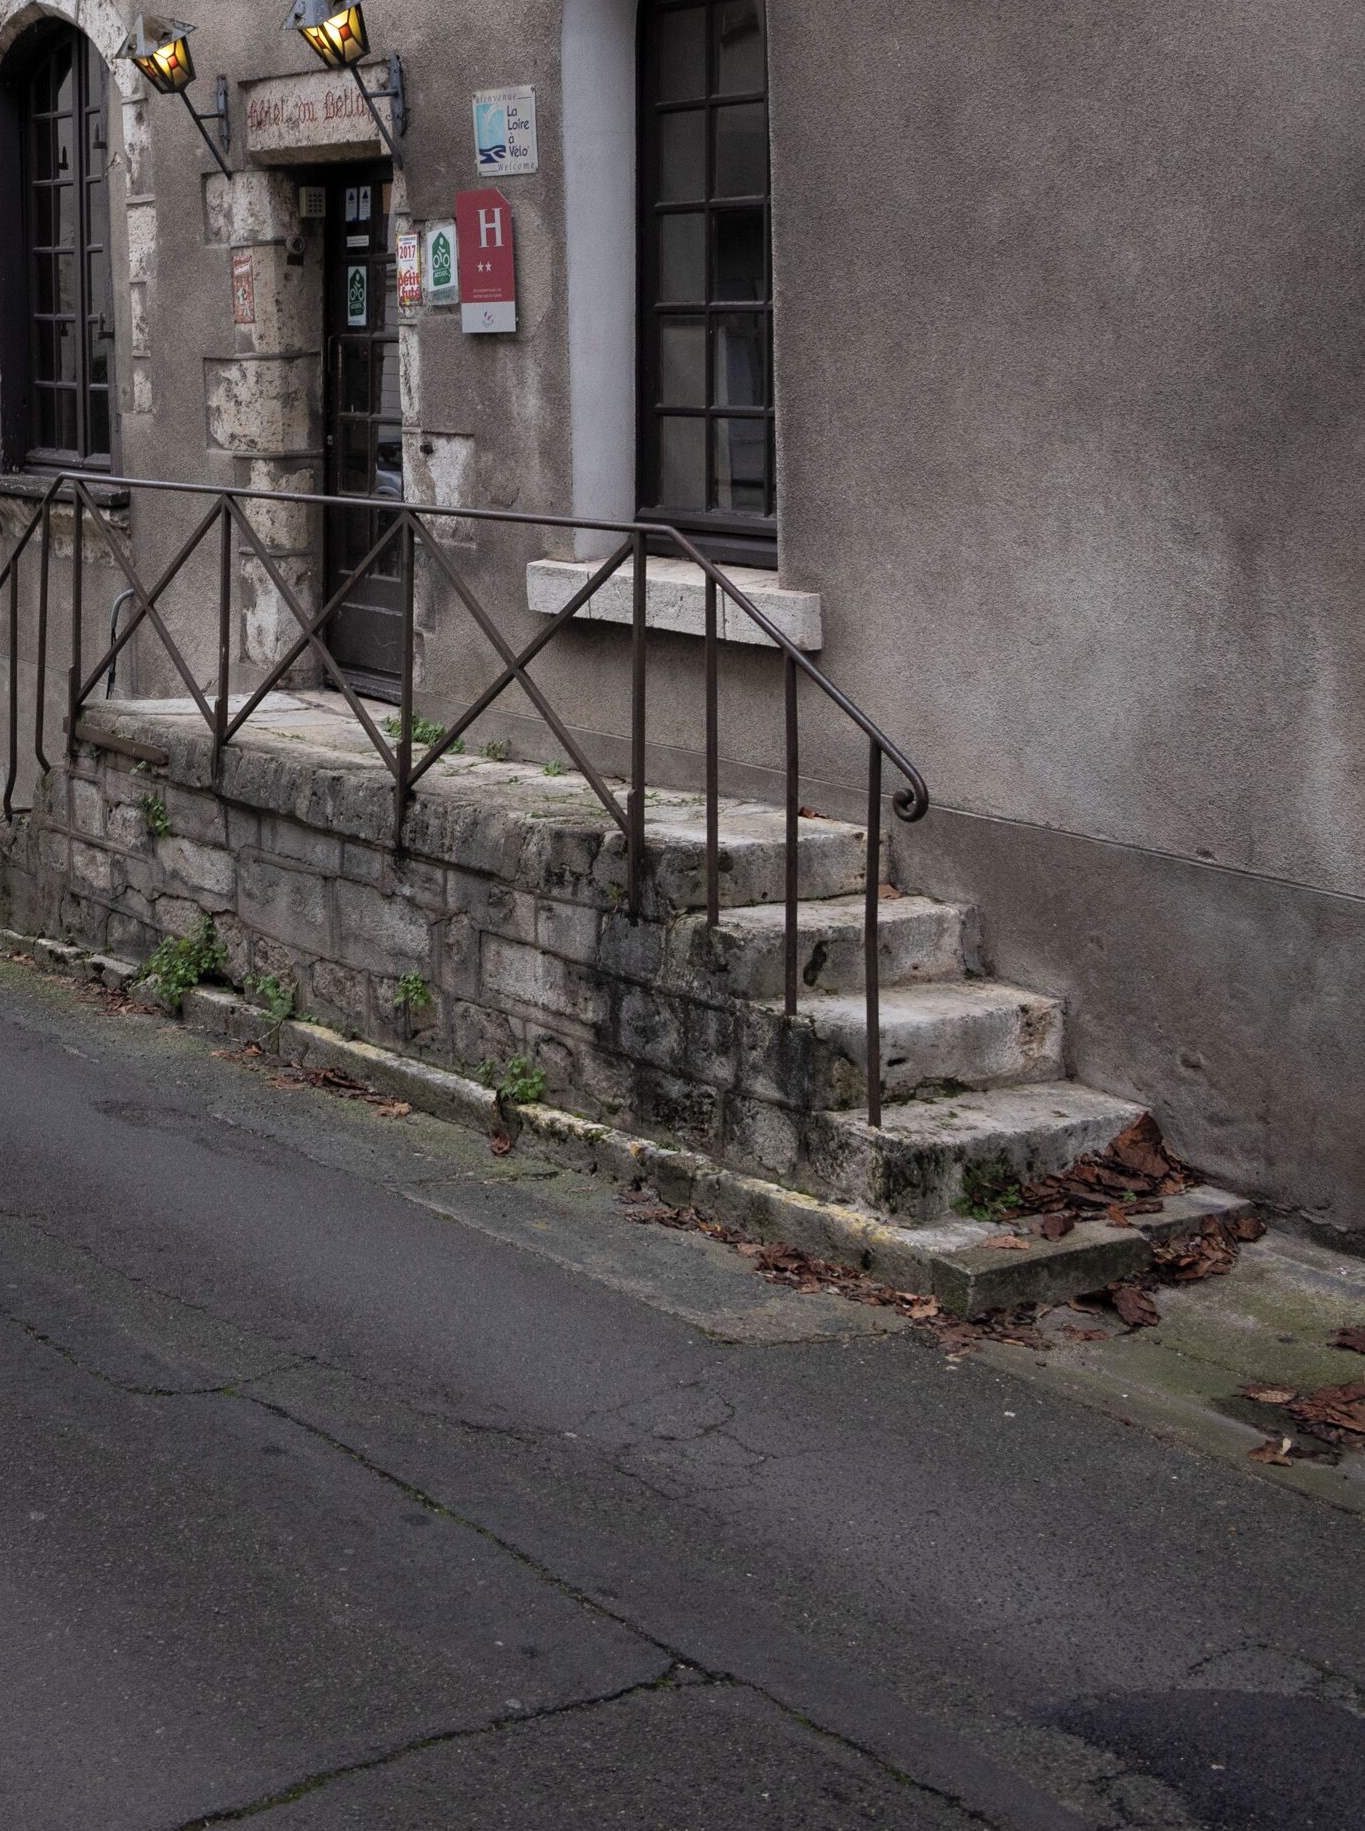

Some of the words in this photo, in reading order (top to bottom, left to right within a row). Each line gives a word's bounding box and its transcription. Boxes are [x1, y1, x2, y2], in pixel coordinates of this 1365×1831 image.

[507, 105, 518, 117] La
[507, 118, 530, 131] Loire
[508, 131, 515, 144] à
[497, 162, 535, 171] Welcome
[476, 207, 505, 248] H
[399, 245, 416, 259] 2017
